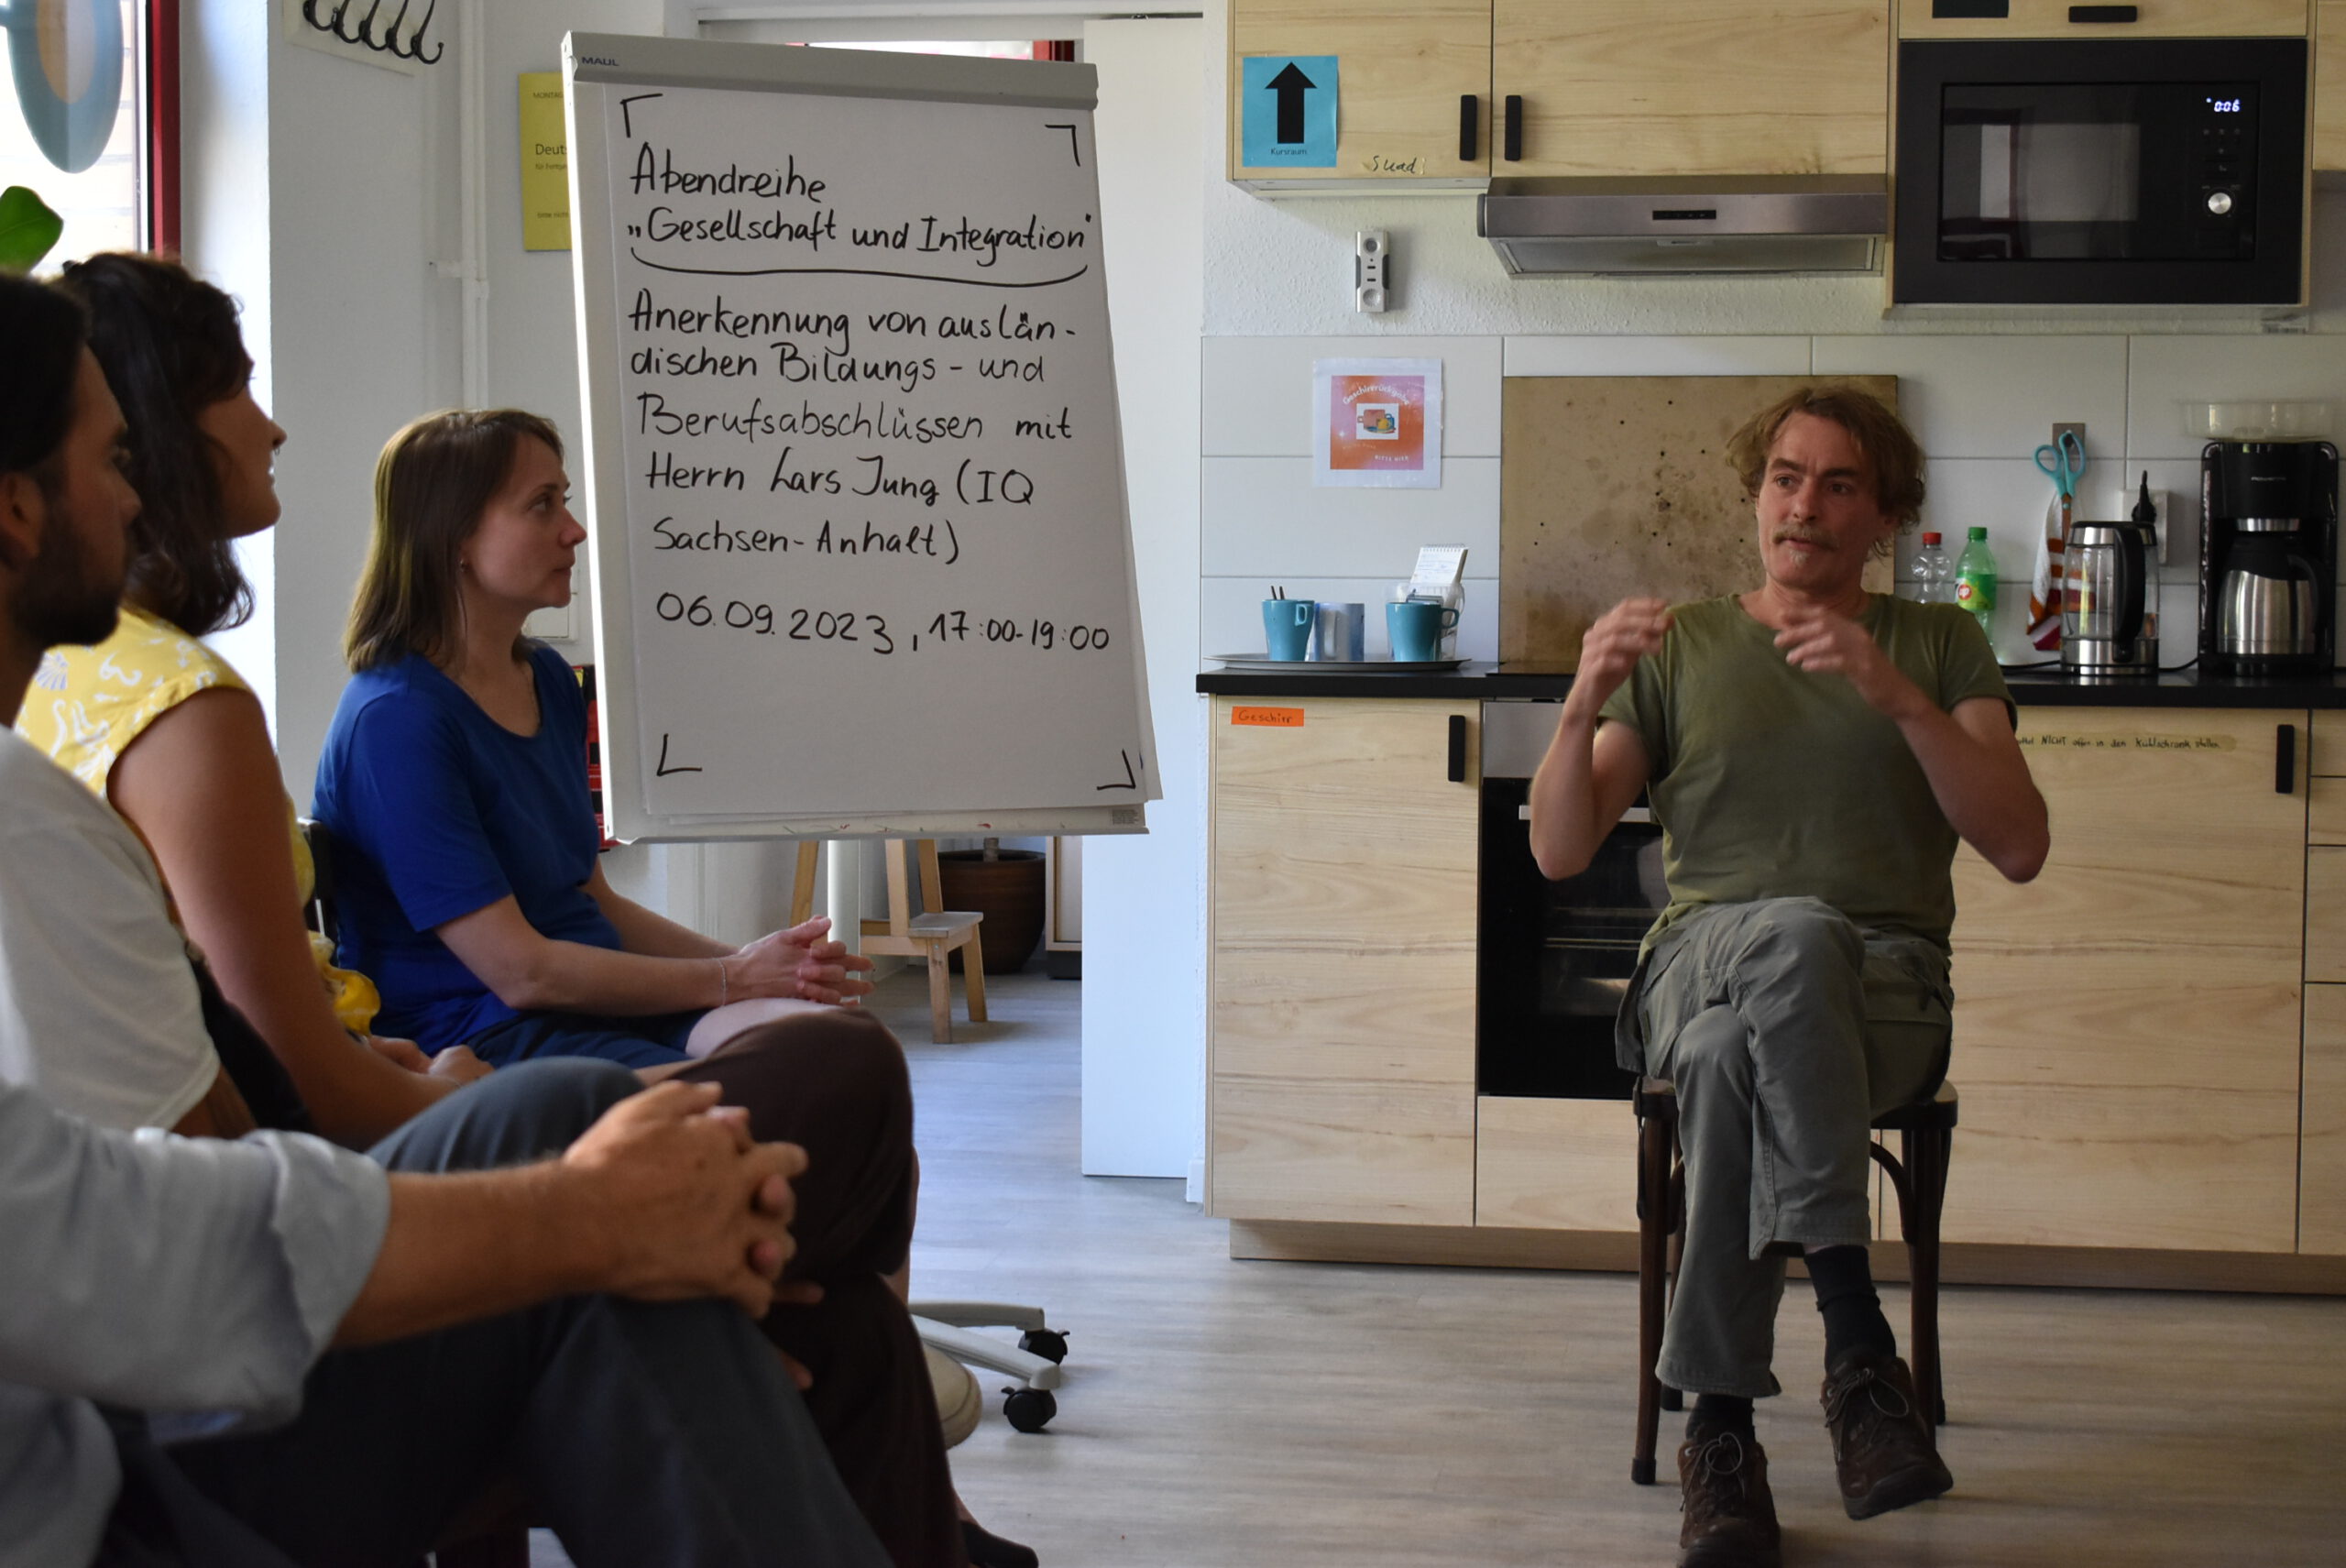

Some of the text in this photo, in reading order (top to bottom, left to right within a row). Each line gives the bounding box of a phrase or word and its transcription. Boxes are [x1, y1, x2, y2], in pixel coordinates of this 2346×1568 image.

[582, 57, 619, 66] MAUL
[1270, 148, 1308, 156] Kursraum
[630, 141, 827, 203] Abendreihe
[851, 222, 910, 250] und
[627, 287, 850, 357] Anerkennung
[868, 311, 926, 337] von
[630, 345, 758, 378] dischen
[979, 356, 1045, 382] und
[636, 391, 1072, 444] Berufsabschlüssen mit
[644, 445, 1035, 508] Herrn Lars Jung (IQ
[652, 516, 959, 565] Sachsen-Anhalt)
[1238, 709, 1293, 724] Geschirr
[2041, 734, 2066, 746] NICHT
[2110, 739, 2127, 748] den
